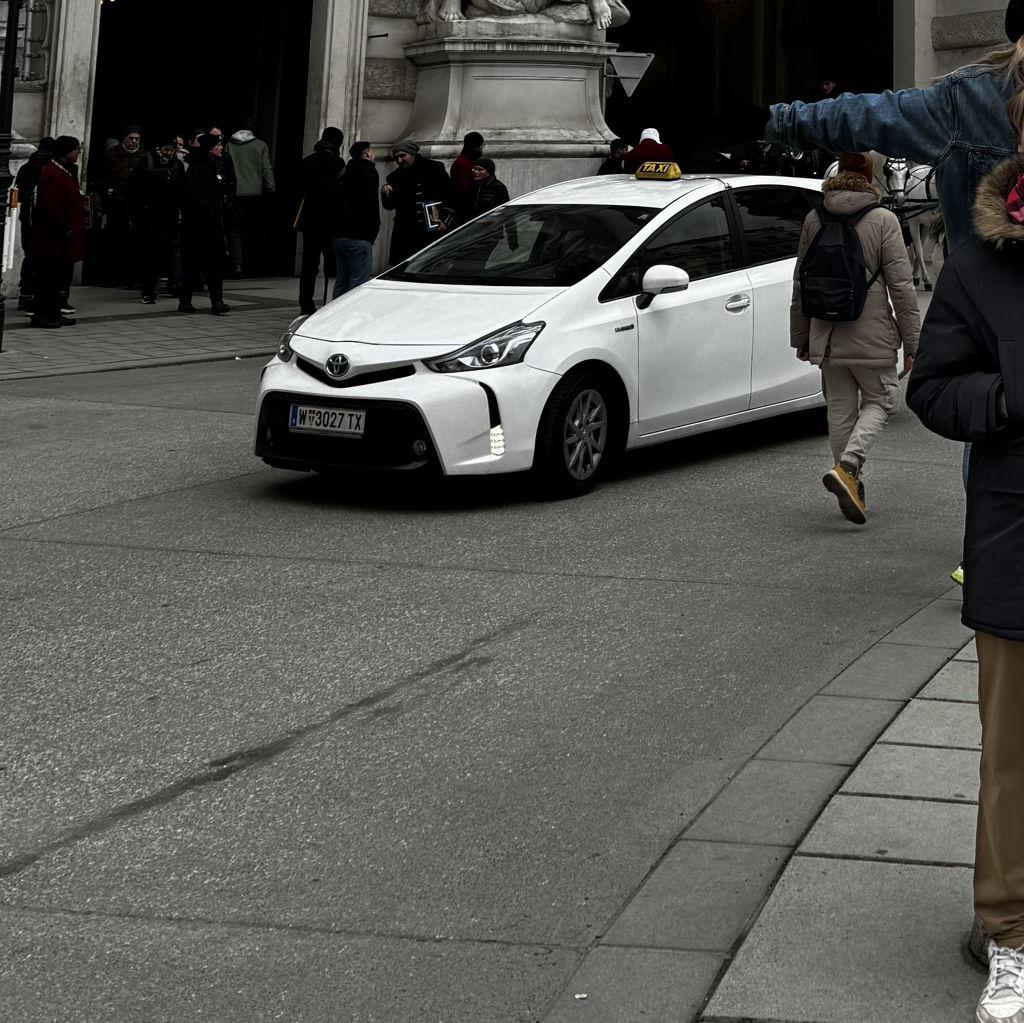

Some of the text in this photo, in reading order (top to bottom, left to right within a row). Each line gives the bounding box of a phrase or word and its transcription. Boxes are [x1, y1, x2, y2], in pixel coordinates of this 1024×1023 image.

[642, 163, 670, 173] TAXI
[315, 410, 344, 429] 3027
[348, 413, 362, 431] TX
